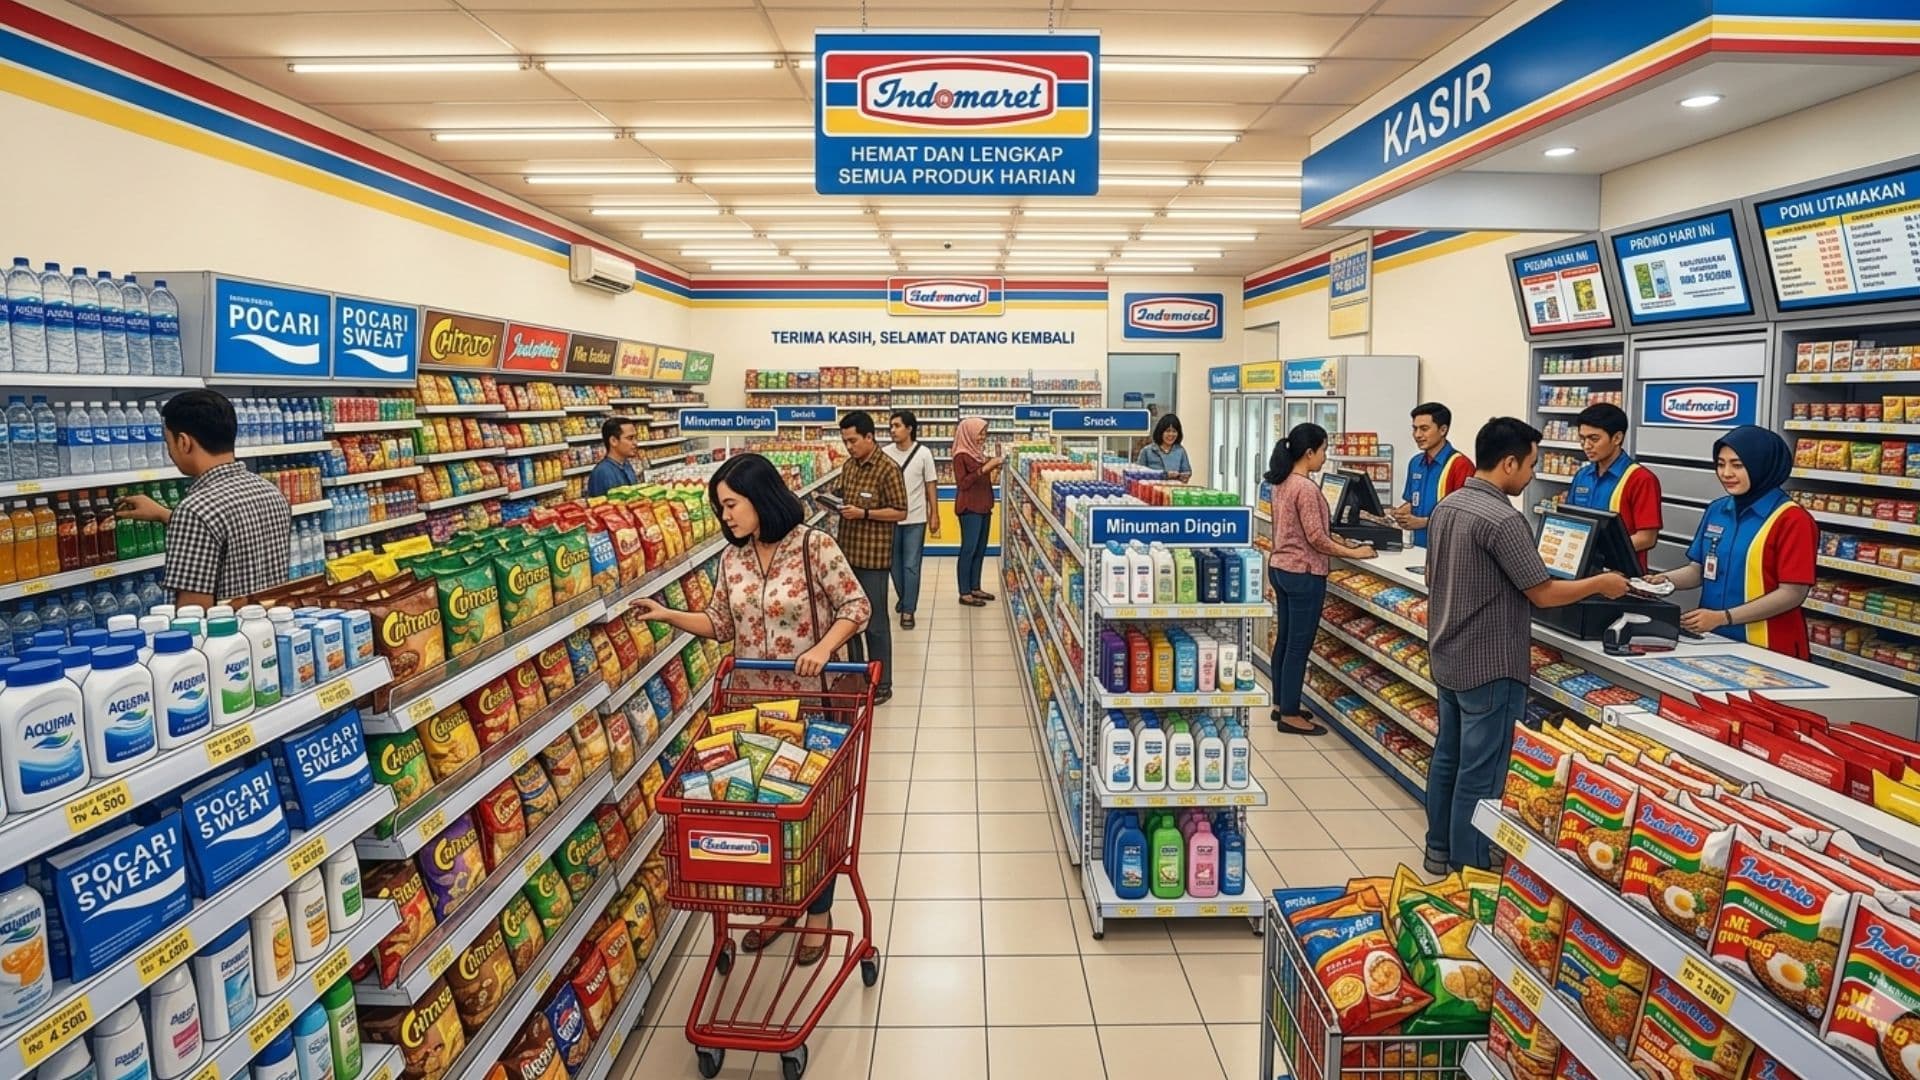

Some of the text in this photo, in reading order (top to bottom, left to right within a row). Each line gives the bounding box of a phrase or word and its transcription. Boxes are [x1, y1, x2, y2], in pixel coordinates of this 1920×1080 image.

[873, 78, 1042, 109] Indomaret
[1382, 62, 1493, 163] KASIR
[851, 146, 1063, 163] HEMAT DAN LENGKAP
[838, 168, 1076, 185] SEMUA PRODUK HARIAN
[1817, 181, 1906, 213] UTAMAKAN
[1669, 228, 1697, 245] HARI
[1699, 222, 1715, 237] INI
[229, 304, 320, 336] POCARI
[342, 306, 408, 331] POCARI
[342, 327, 404, 349] SWEAT
[771, 330, 1076, 348] TERIMA KASIH, SELAMAT DATANG KEMBALI
[685, 415, 771, 429] Minuman Dingin
[1106, 517, 1238, 540] Minuman Dingin
[296, 722, 359, 764] POCARI
[301, 737, 359, 778] SWEAT
[195, 771, 273, 824] POCARI
[201, 789, 270, 839] SWEAT
[71, 827, 177, 895] POCARI
[78, 849, 173, 912] SWEAT
